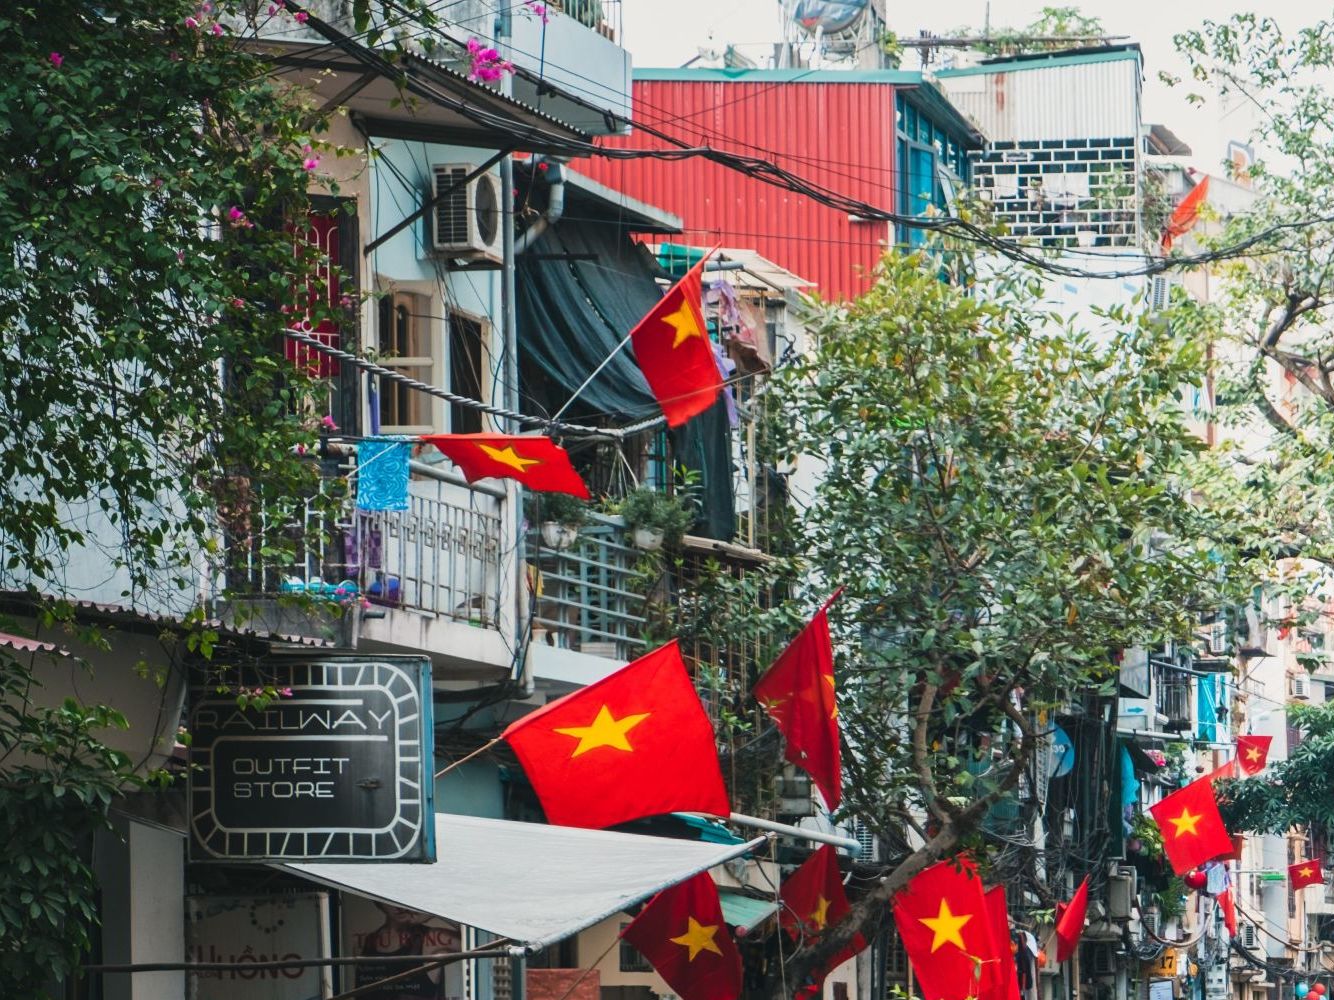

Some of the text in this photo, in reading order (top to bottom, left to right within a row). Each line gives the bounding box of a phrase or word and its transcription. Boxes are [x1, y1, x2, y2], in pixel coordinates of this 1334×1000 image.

[195, 709, 391, 730] RAILWAY
[232, 757, 350, 775] OUTFIT
[233, 781, 335, 799] STORE
[1160, 955, 1174, 969] 17
